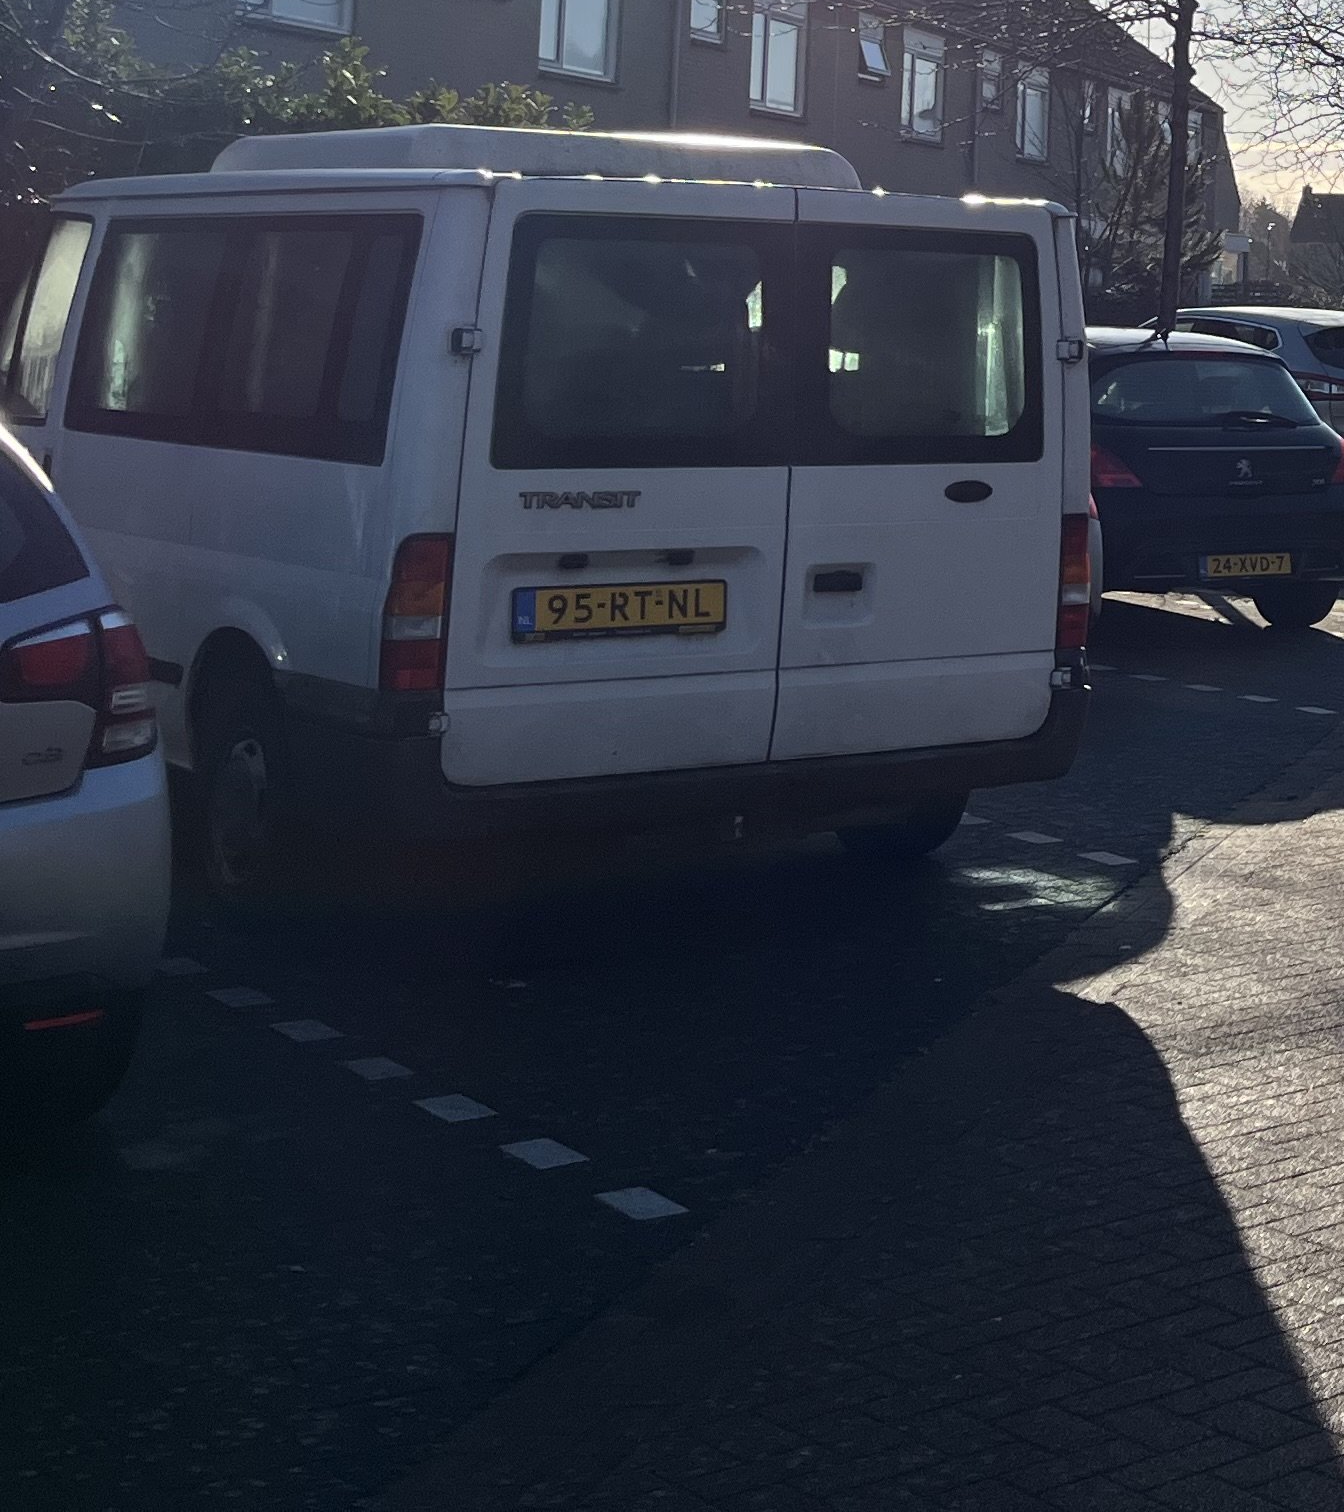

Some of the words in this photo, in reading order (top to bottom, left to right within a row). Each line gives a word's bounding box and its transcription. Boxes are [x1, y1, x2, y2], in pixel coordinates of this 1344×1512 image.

[519, 490, 642, 509] TRANSIT
[1211, 555, 1285, 574] 24-XVD-7
[547, 589, 712, 625] 95-RT-NL
